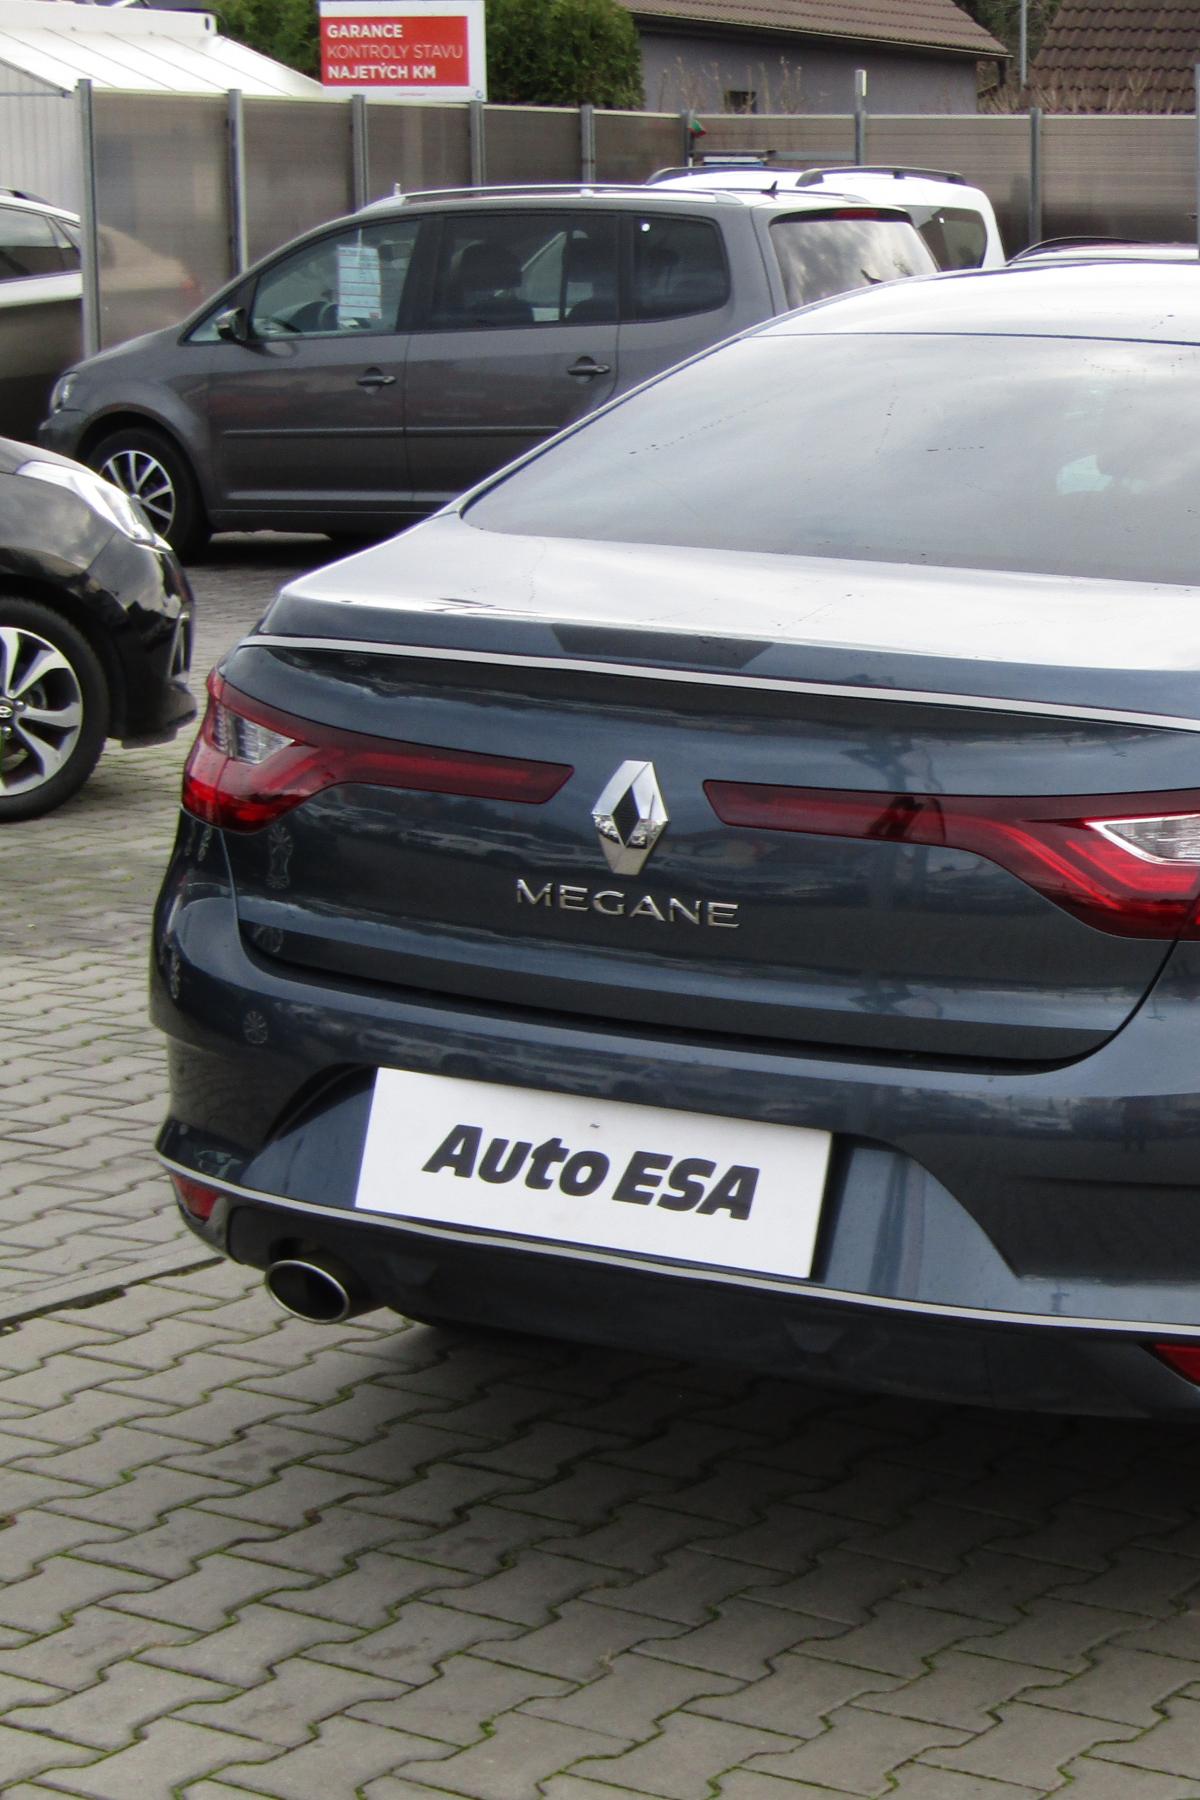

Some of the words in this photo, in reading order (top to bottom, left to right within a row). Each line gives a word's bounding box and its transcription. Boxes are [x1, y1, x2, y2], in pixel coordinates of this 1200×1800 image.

[327, 24, 403, 39] GARANCE
[327, 44, 410, 60] KONTROLY
[413, 44, 464, 59] STAVU
[327, 62, 409, 79] NAJETÝCH
[412, 65, 437, 79] KM
[515, 878, 741, 929] MEGANE
[421, 1123, 610, 1197] Auto
[611, 1150, 761, 1221] ESA
